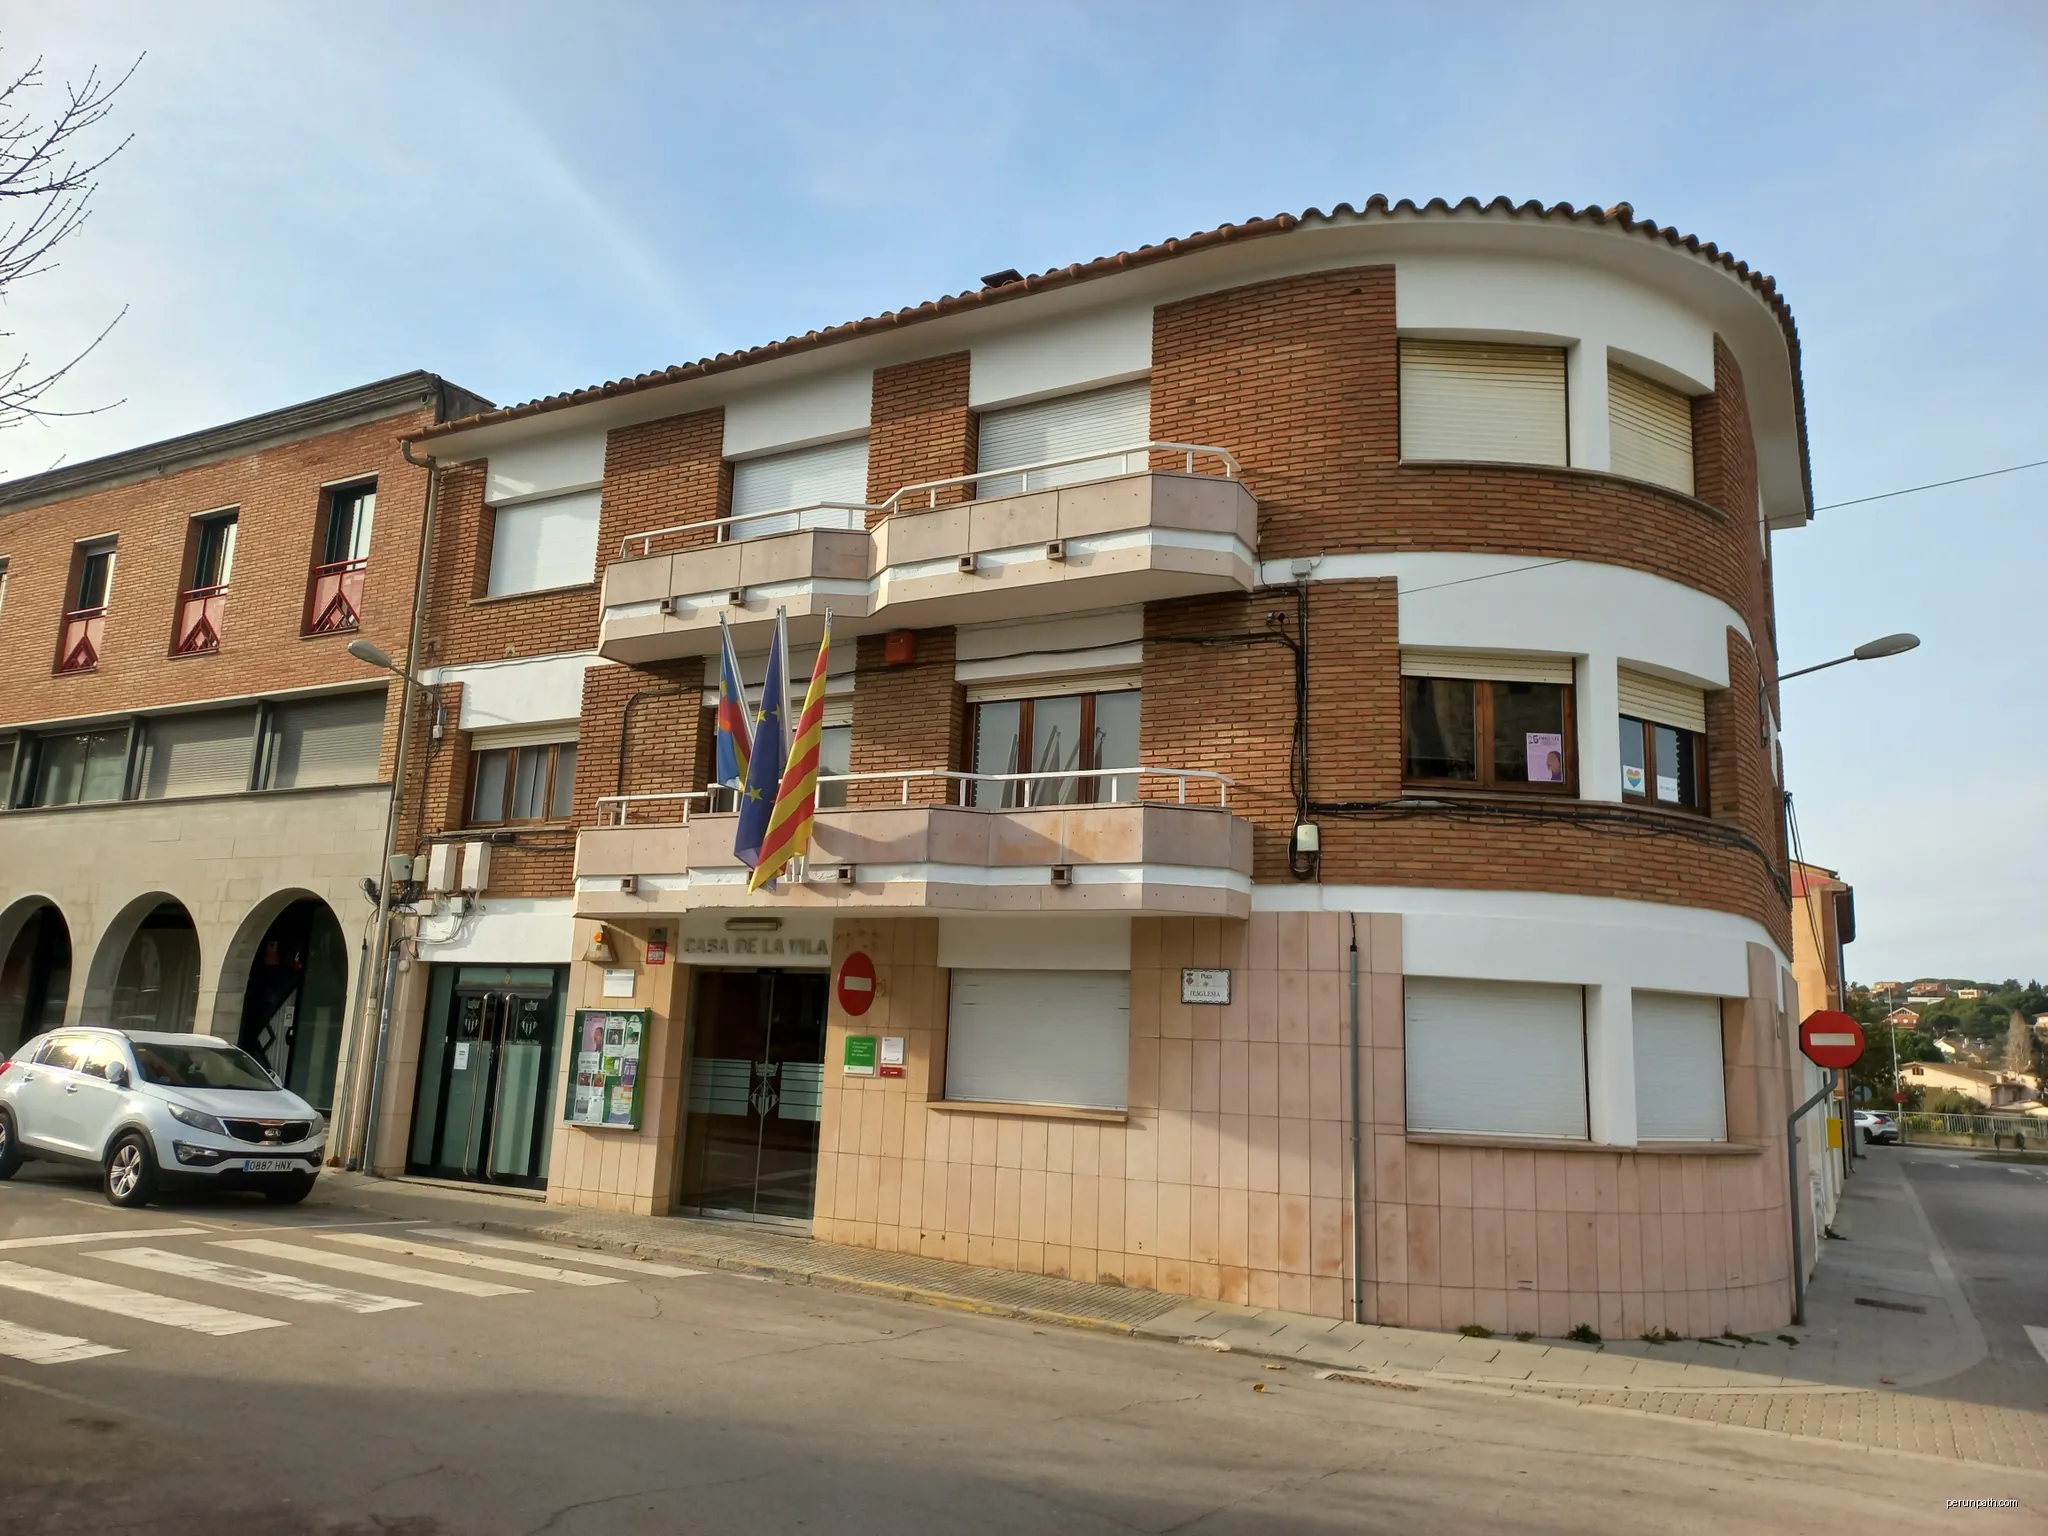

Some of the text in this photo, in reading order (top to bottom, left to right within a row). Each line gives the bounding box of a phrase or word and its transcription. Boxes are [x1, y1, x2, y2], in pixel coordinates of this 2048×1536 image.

[684, 937, 829, 955] CASA DE LA VILA
[249, 1161, 292, 1171] 0887 HNX
